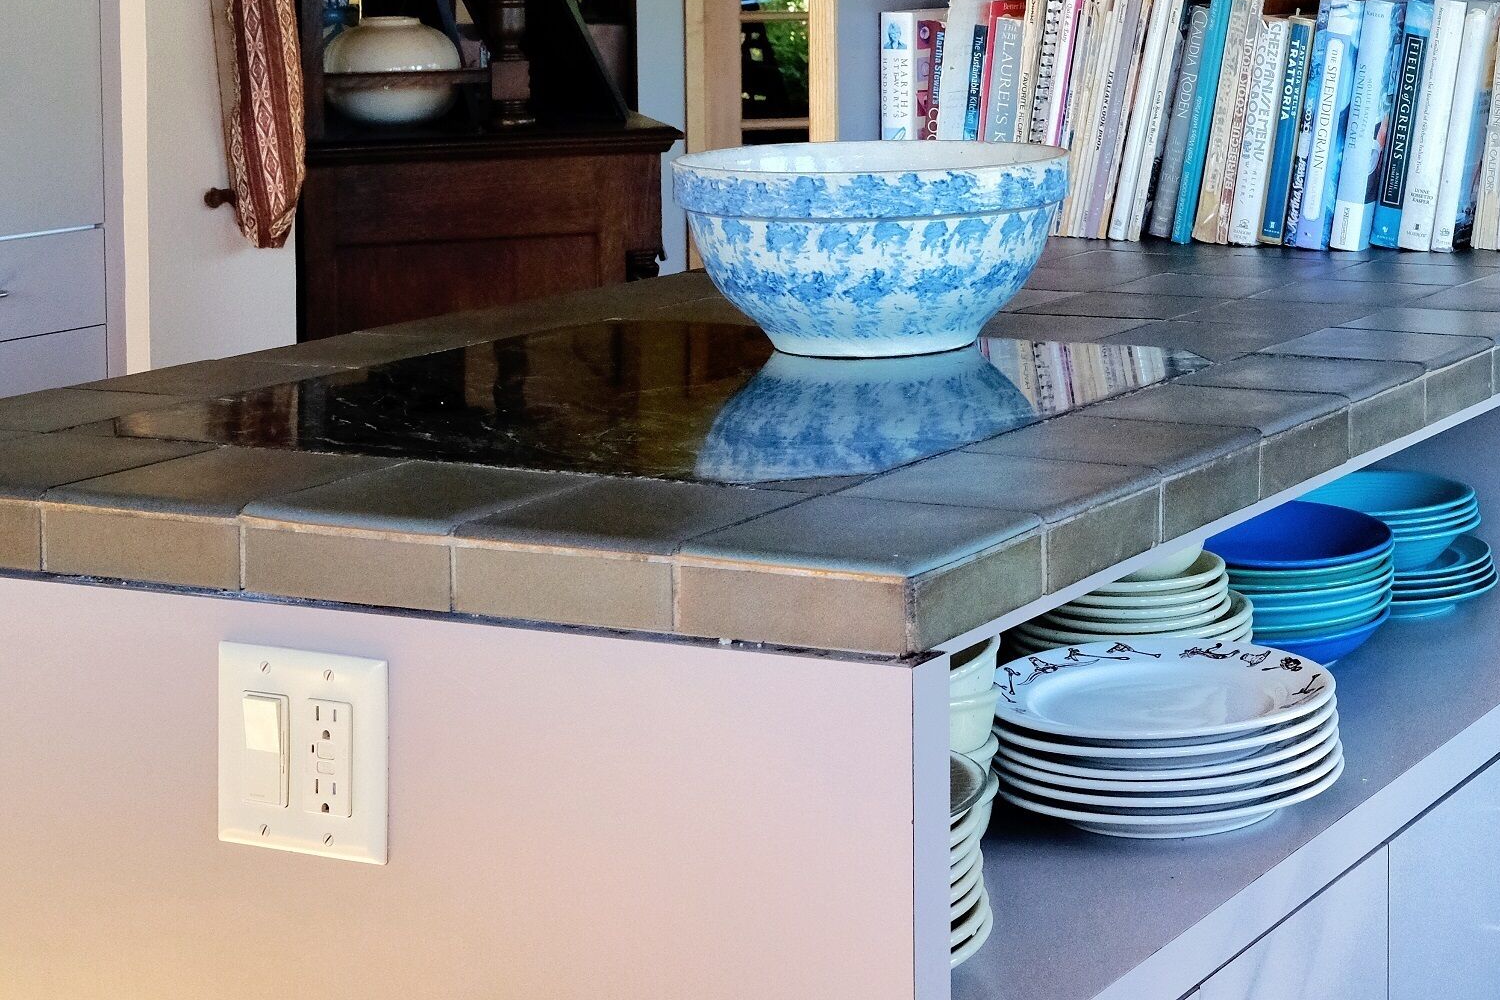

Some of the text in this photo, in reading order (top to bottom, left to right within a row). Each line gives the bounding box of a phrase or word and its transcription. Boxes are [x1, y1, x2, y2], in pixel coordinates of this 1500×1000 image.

[900, 58, 908, 118] MARTHA
[967, 36, 984, 124] The Sustainable Kitchen
[995, 40, 1015, 125] LAUREL'S
[1019, 72, 1029, 110] FAVORITE
[1104, 70, 1115, 104] ITALIAN
[1178, 10, 1208, 119] CLAUDIA RODEN
[1245, 44, 1266, 136] COOKBOOK
[1280, 40, 1300, 120] TRATTORIA
[1295, 45, 1305, 84] PATRICIA
[1319, 62, 1338, 127] SPLENDID
[1352, 63, 1367, 120] SUNLIGHT
[1393, 42, 1420, 160] FIELDS of GREENS
[1186, 147, 1194, 165] Fresh
[1225, 119, 1242, 190] BARBECUE
[1253, 119, 1269, 162] MENU
[1313, 128, 1328, 170] GRAIN
